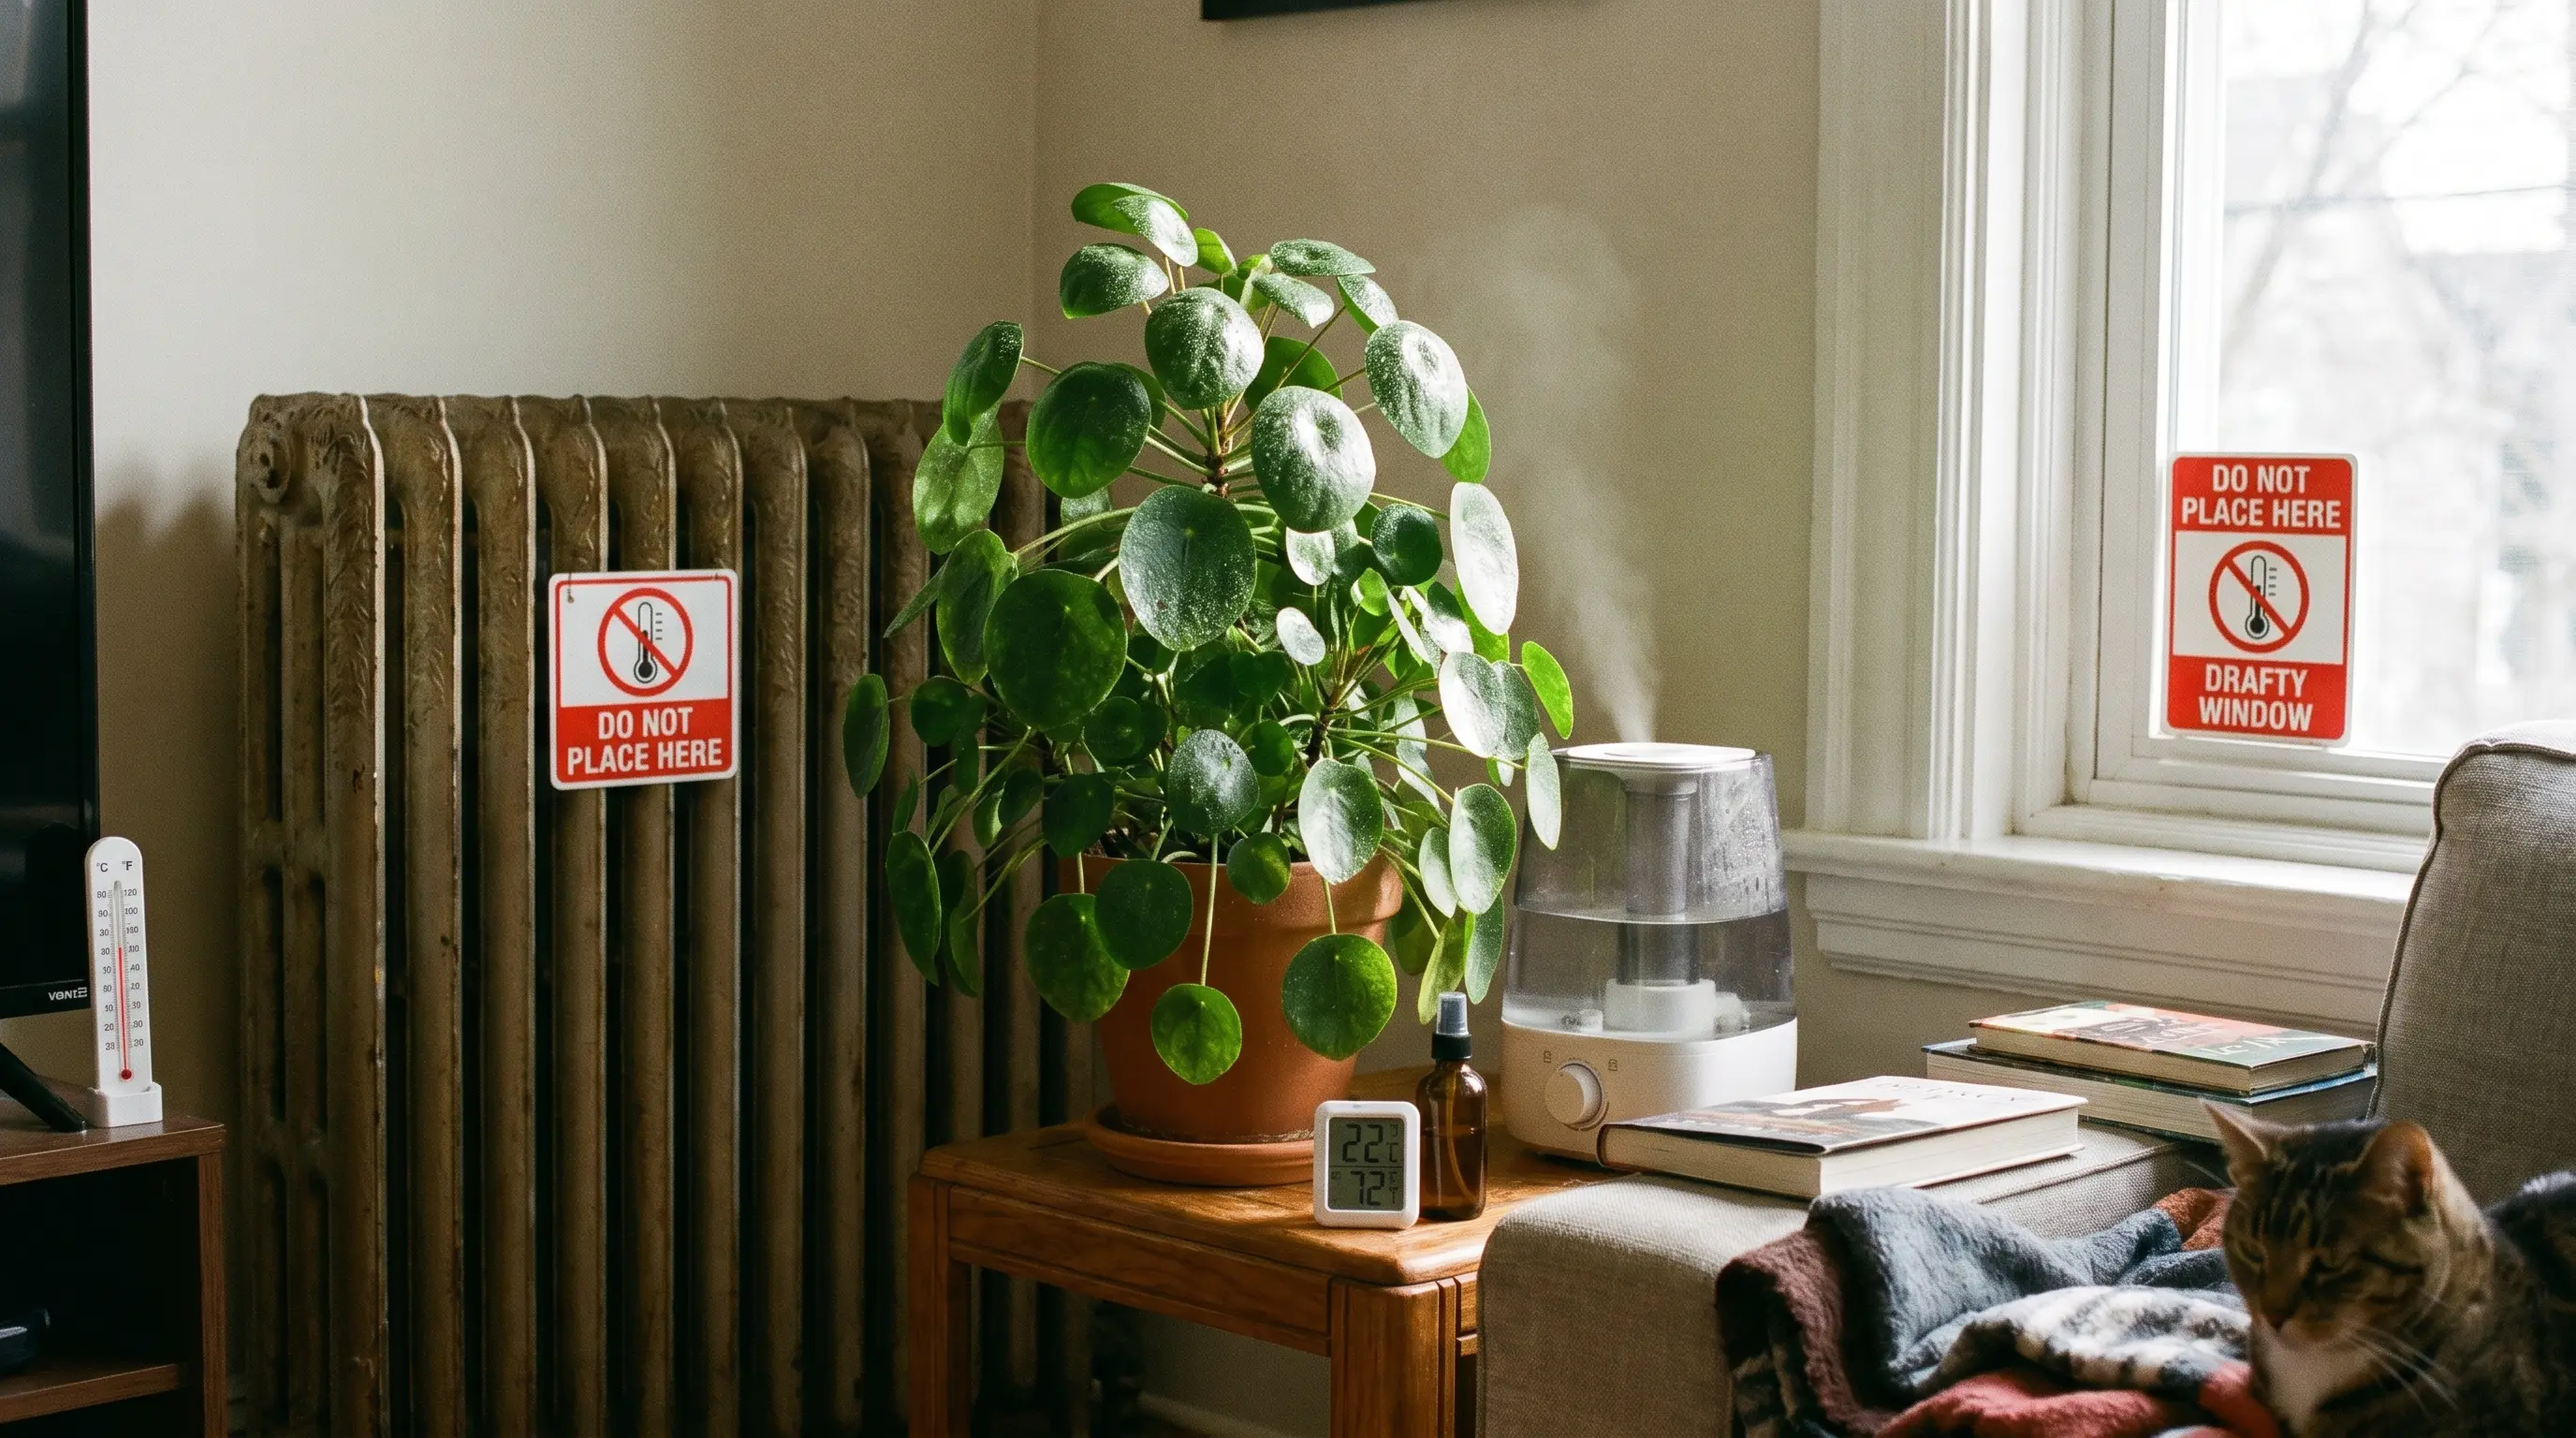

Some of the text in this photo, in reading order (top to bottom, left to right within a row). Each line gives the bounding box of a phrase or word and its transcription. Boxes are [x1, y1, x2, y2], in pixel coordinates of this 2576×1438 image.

[2212, 464, 2311, 494] DO NOT
[2182, 496, 2341, 529] PLACE HERE
[2204, 664, 2308, 697] DRAFTY
[598, 707, 693, 740] DO NOT
[2199, 696, 2313, 732] WINDOW
[567, 738, 723, 776] PLACE HERE
[124, 888, 138, 897] 120
[104, 1023, 114, 1032] 20
[1342, 1123, 1383, 1163] 22
[1350, 1171, 1384, 1207] 72
